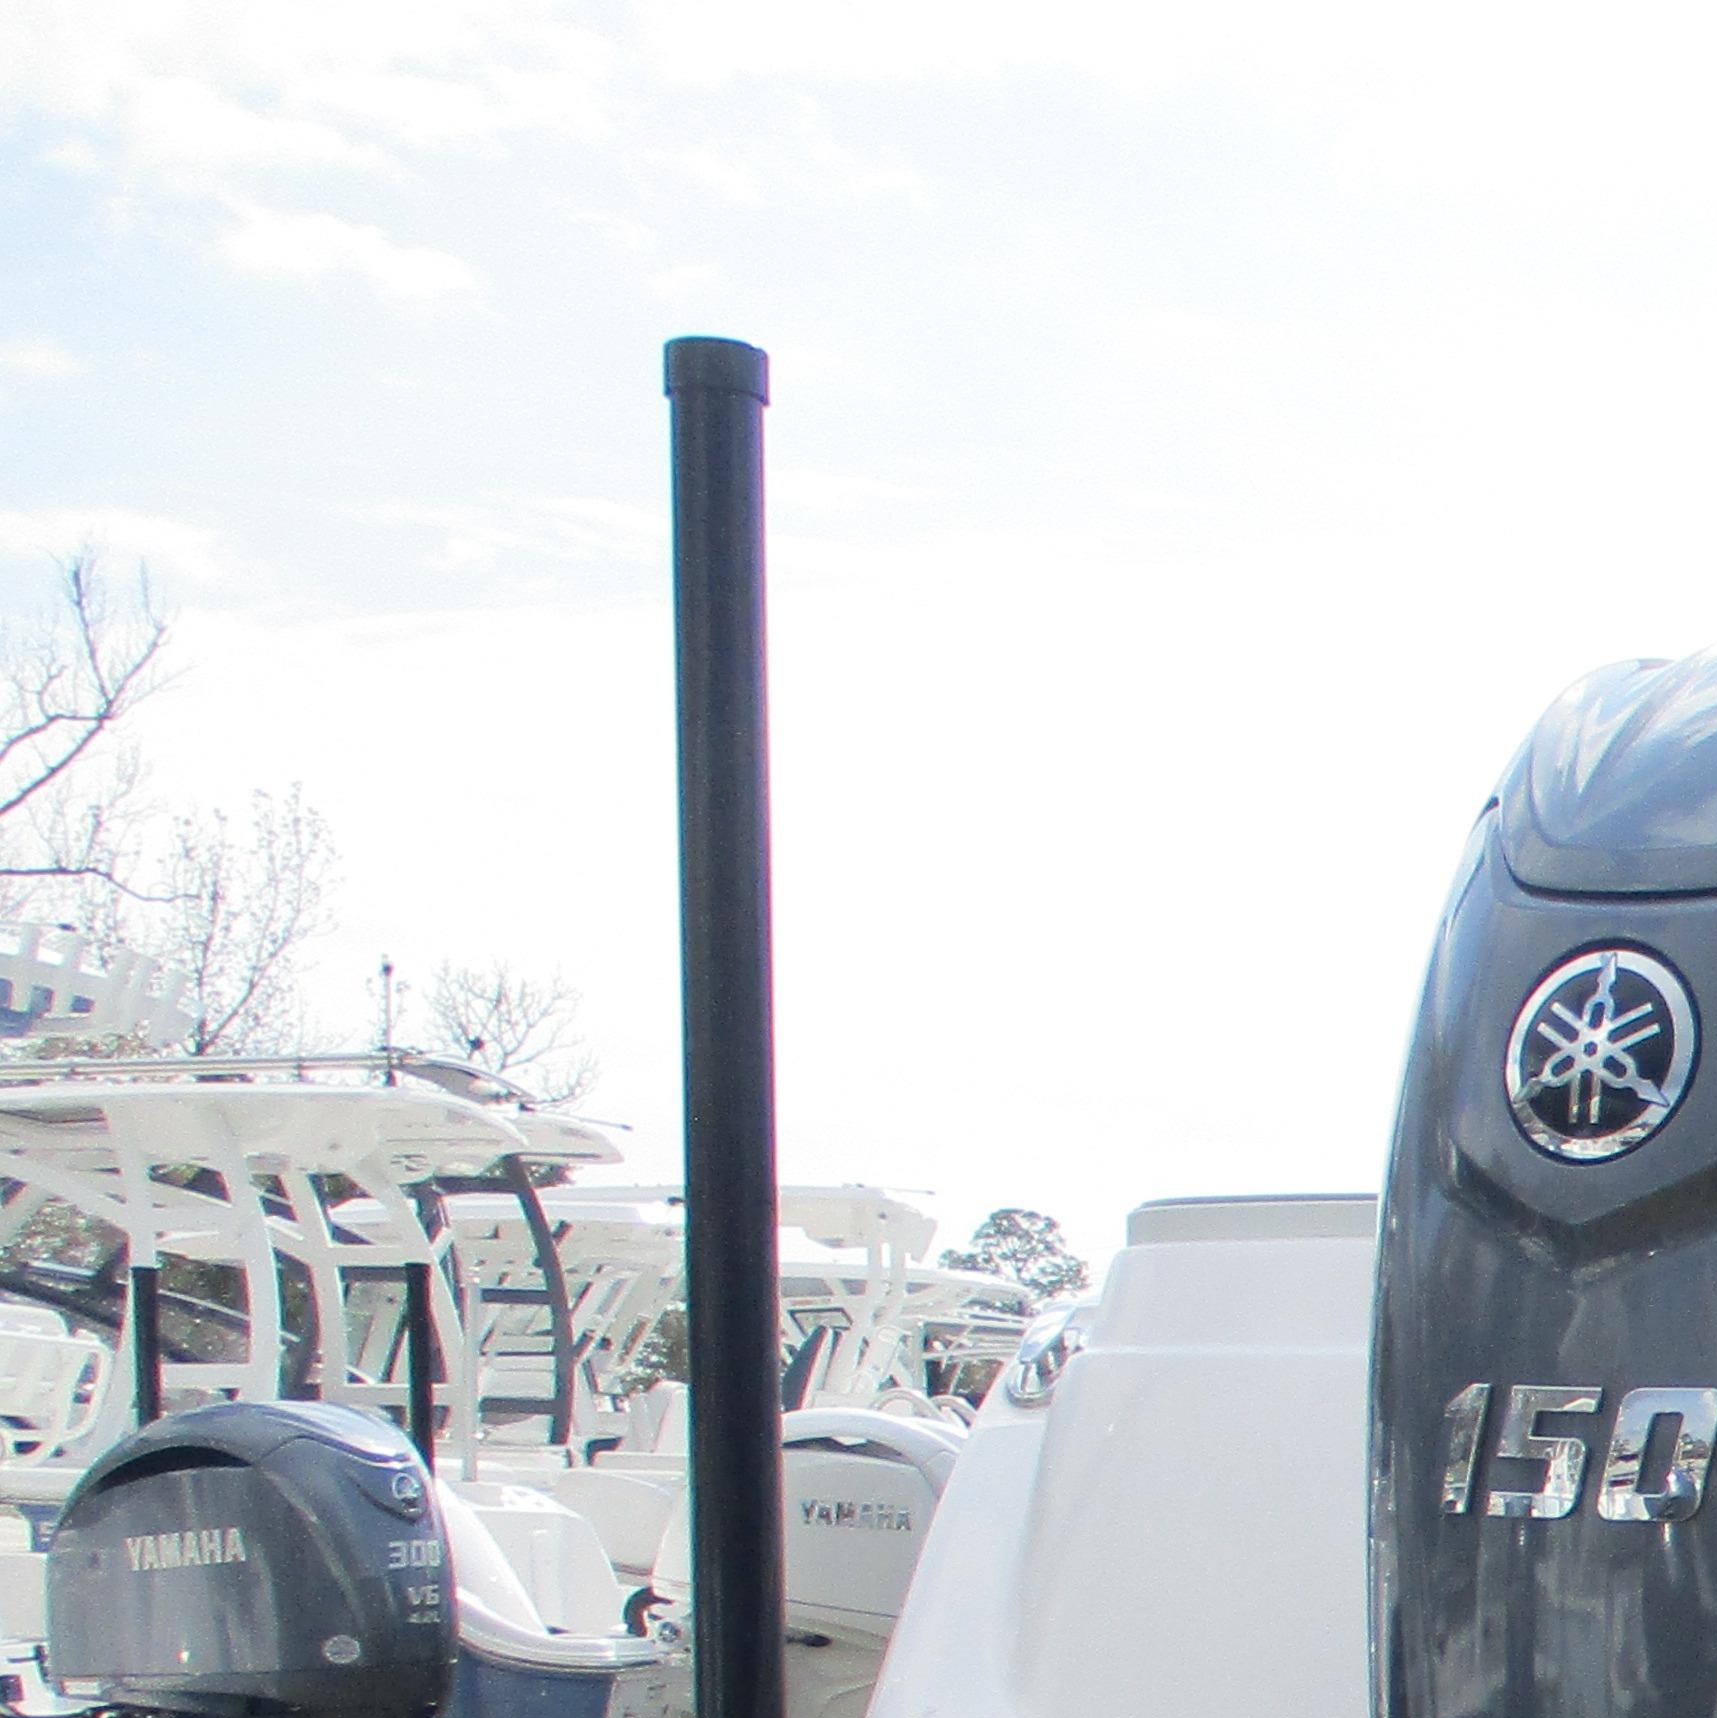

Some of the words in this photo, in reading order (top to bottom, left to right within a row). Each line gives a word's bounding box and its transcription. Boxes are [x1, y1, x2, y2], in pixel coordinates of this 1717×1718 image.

[801, 1499, 913, 1531] YAMAHA
[124, 1527, 247, 1572] YAMAHA
[388, 1540, 441, 1569] 300
[407, 1584, 440, 1605] V6
